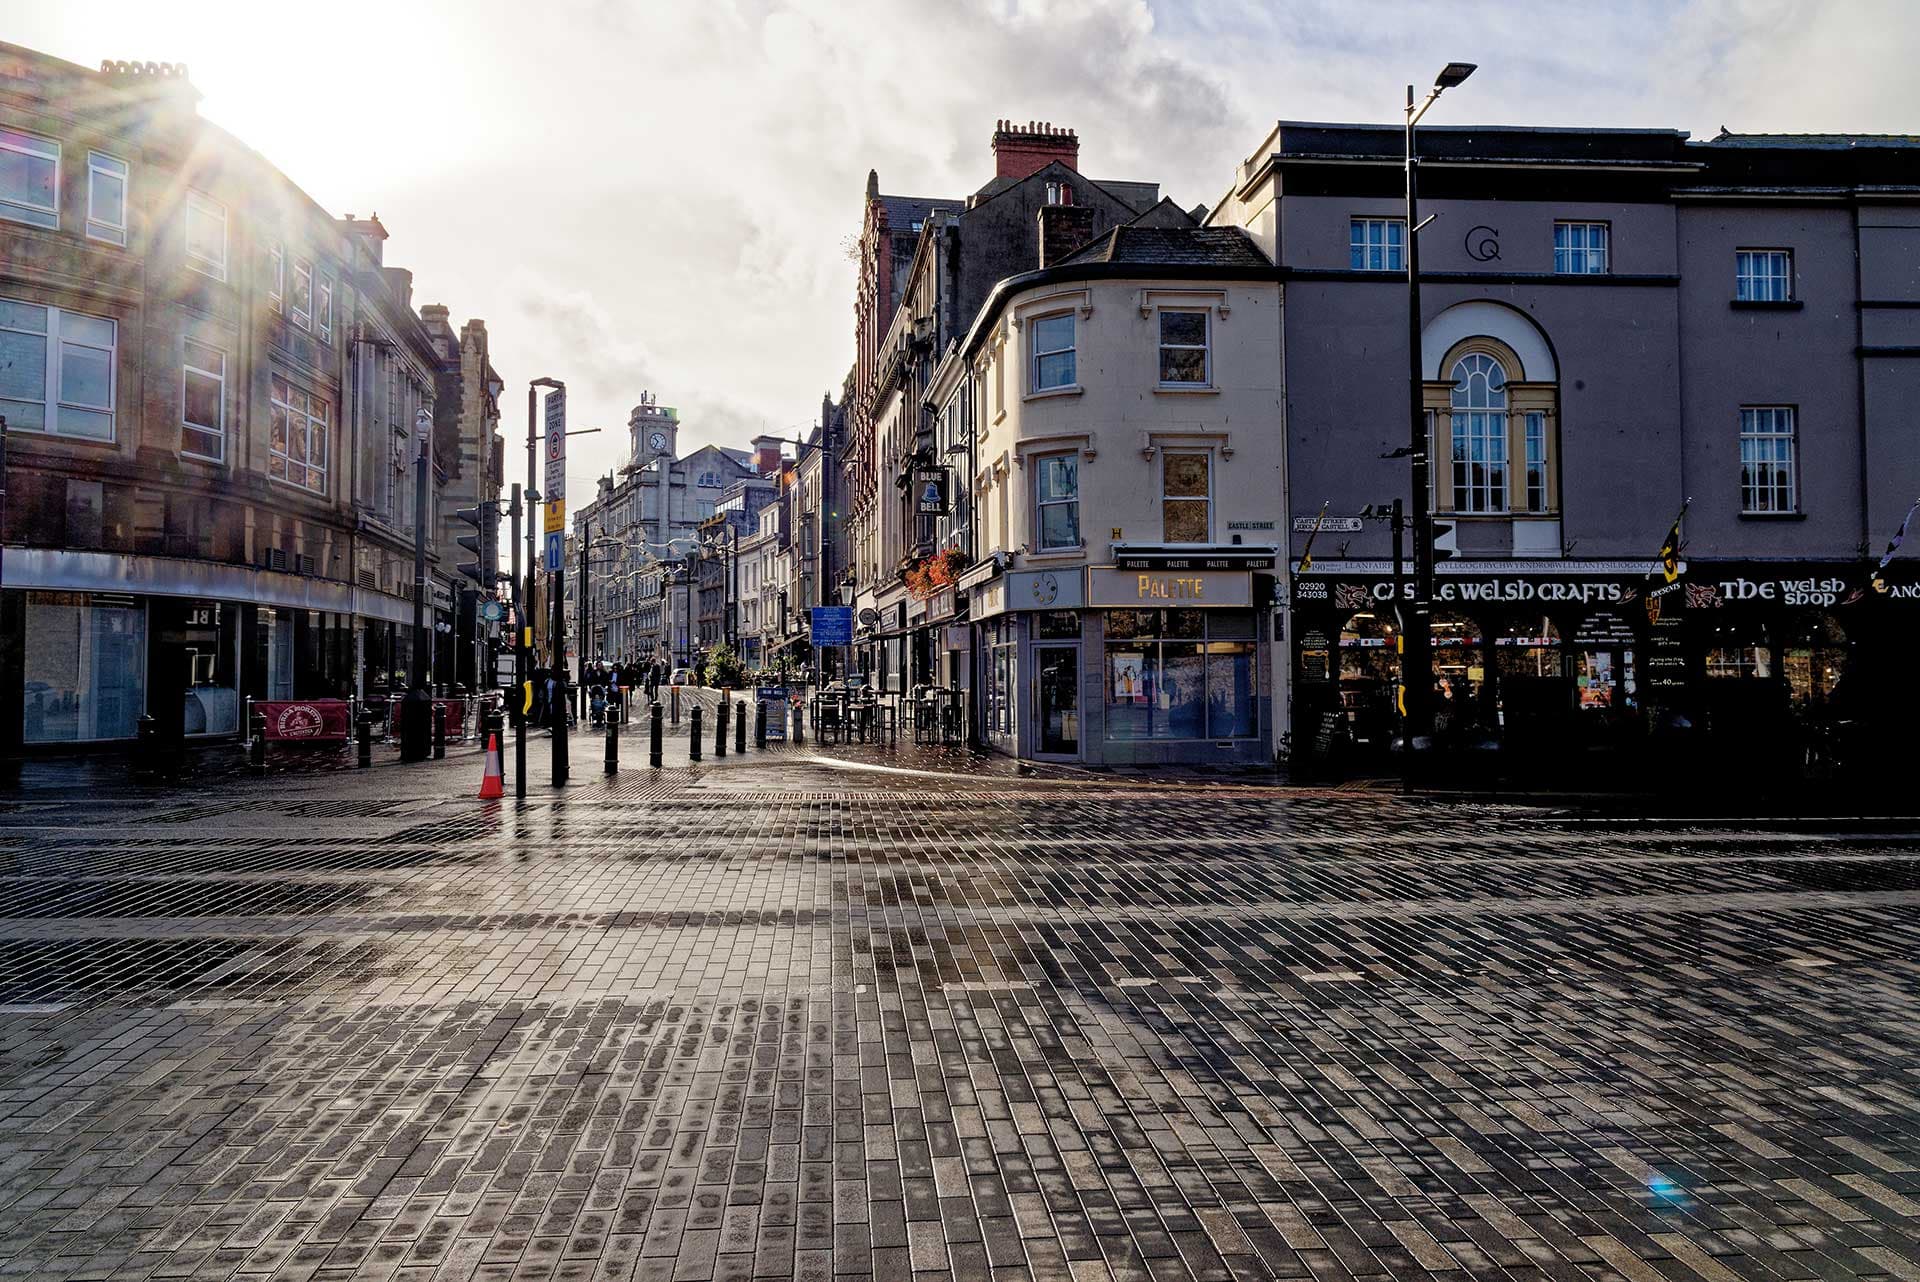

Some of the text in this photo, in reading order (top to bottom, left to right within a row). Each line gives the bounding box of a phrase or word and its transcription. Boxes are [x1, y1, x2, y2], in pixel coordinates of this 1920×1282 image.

[920, 471, 943, 481] BLUE
[920, 502, 943, 512] BELL
[1228, 521, 1274, 529] CASTLE STREET
[1126, 560, 1149, 568] PALETTE
[1166, 560, 1189, 568] PALETTE
[1206, 560, 1229, 568] PALETTE
[1138, 575, 1204, 599] PALETTE
[1298, 582, 1326, 591] 02920
[1458, 579, 1535, 602] WELSH
[1537, 583, 1622, 604] CRAFTS
[1296, 591, 1328, 599] 343038
[280, 706, 321, 729] BIRRA MORETTI
